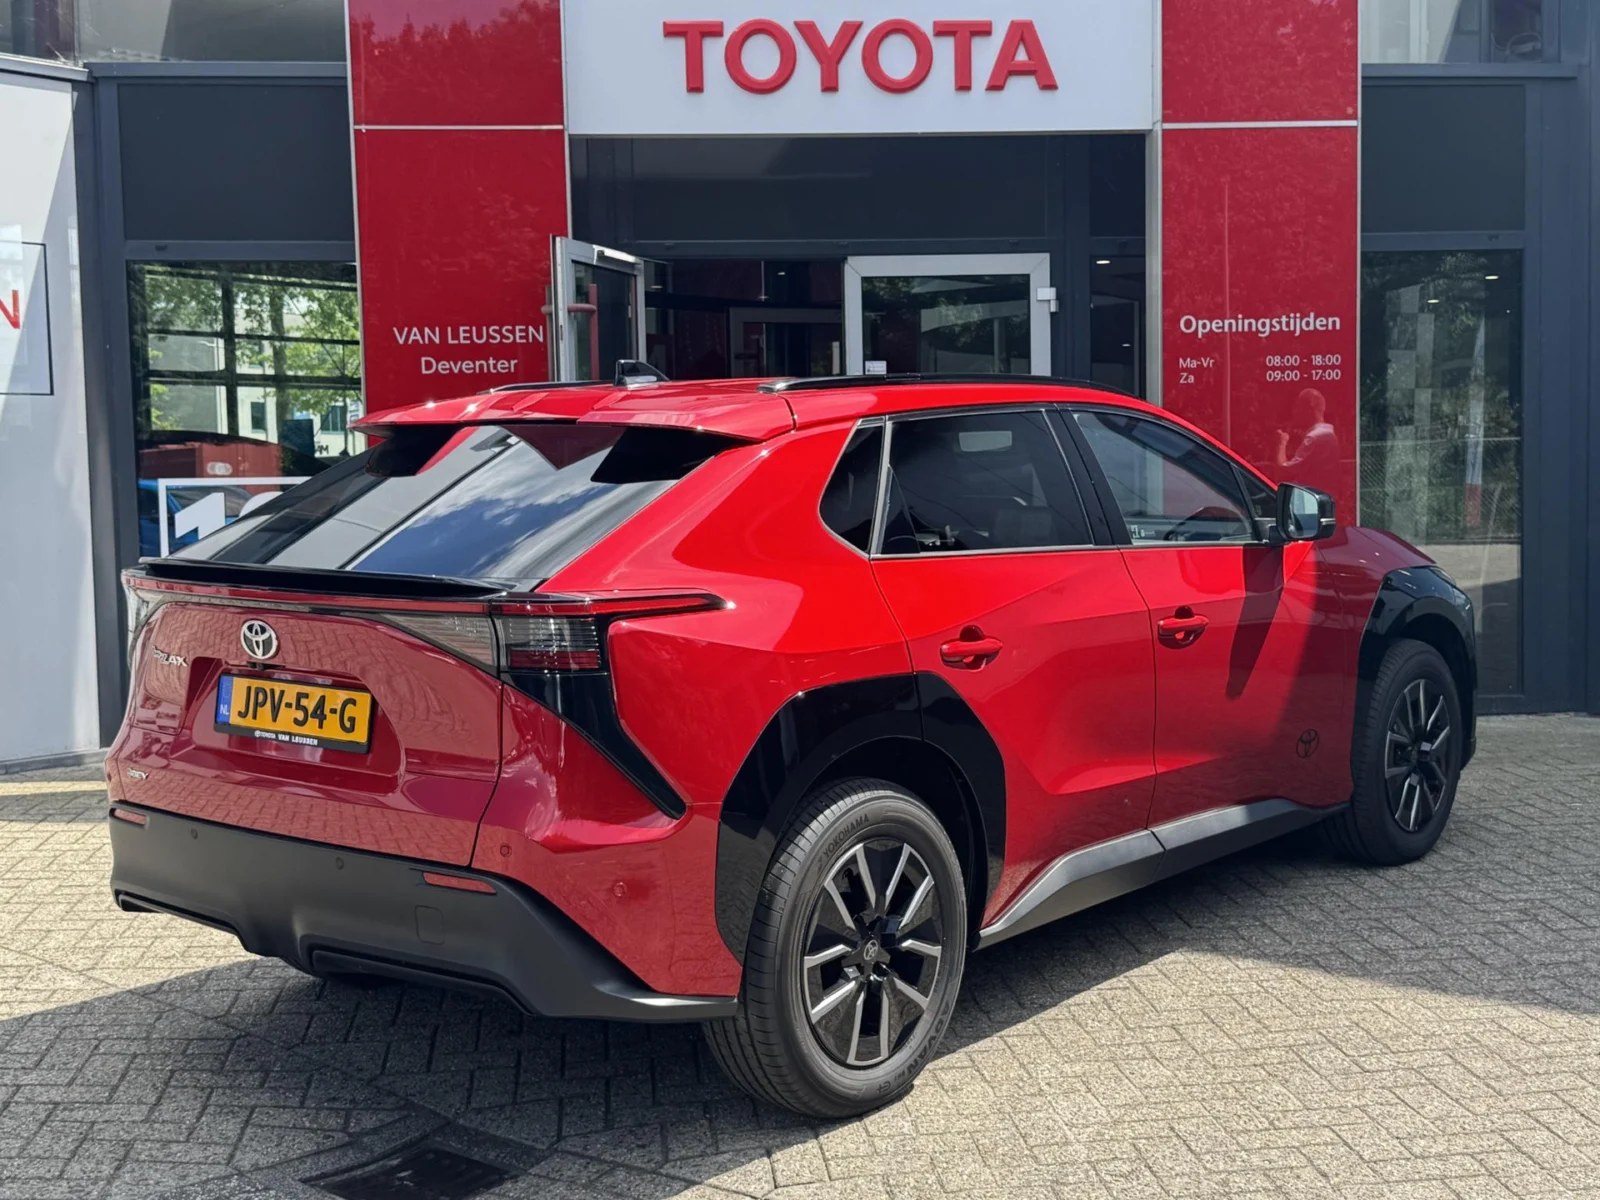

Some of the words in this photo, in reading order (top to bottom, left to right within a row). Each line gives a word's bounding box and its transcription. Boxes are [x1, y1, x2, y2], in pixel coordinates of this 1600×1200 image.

[662, 18, 1059, 95] TOYOTA
[393, 326, 440, 345] VAN
[447, 325, 544, 344] LEUSSEN
[1179, 312, 1341, 339] Openingstijden
[420, 356, 518, 374] Deventer
[1178, 356, 1215, 369] Ma-Vr
[1265, 355, 1300, 367] 08:00
[1311, 354, 1341, 366] 18:00
[1179, 372, 1195, 384] Za
[1266, 370, 1300, 382] 09:00
[1311, 369, 1341, 381] 17:00
[219, 704, 230, 715] NL
[237, 685, 357, 734] JPV-54-G
[277, 733, 290, 742] VAN
[823, 813, 870, 859] YOKOHAMA
